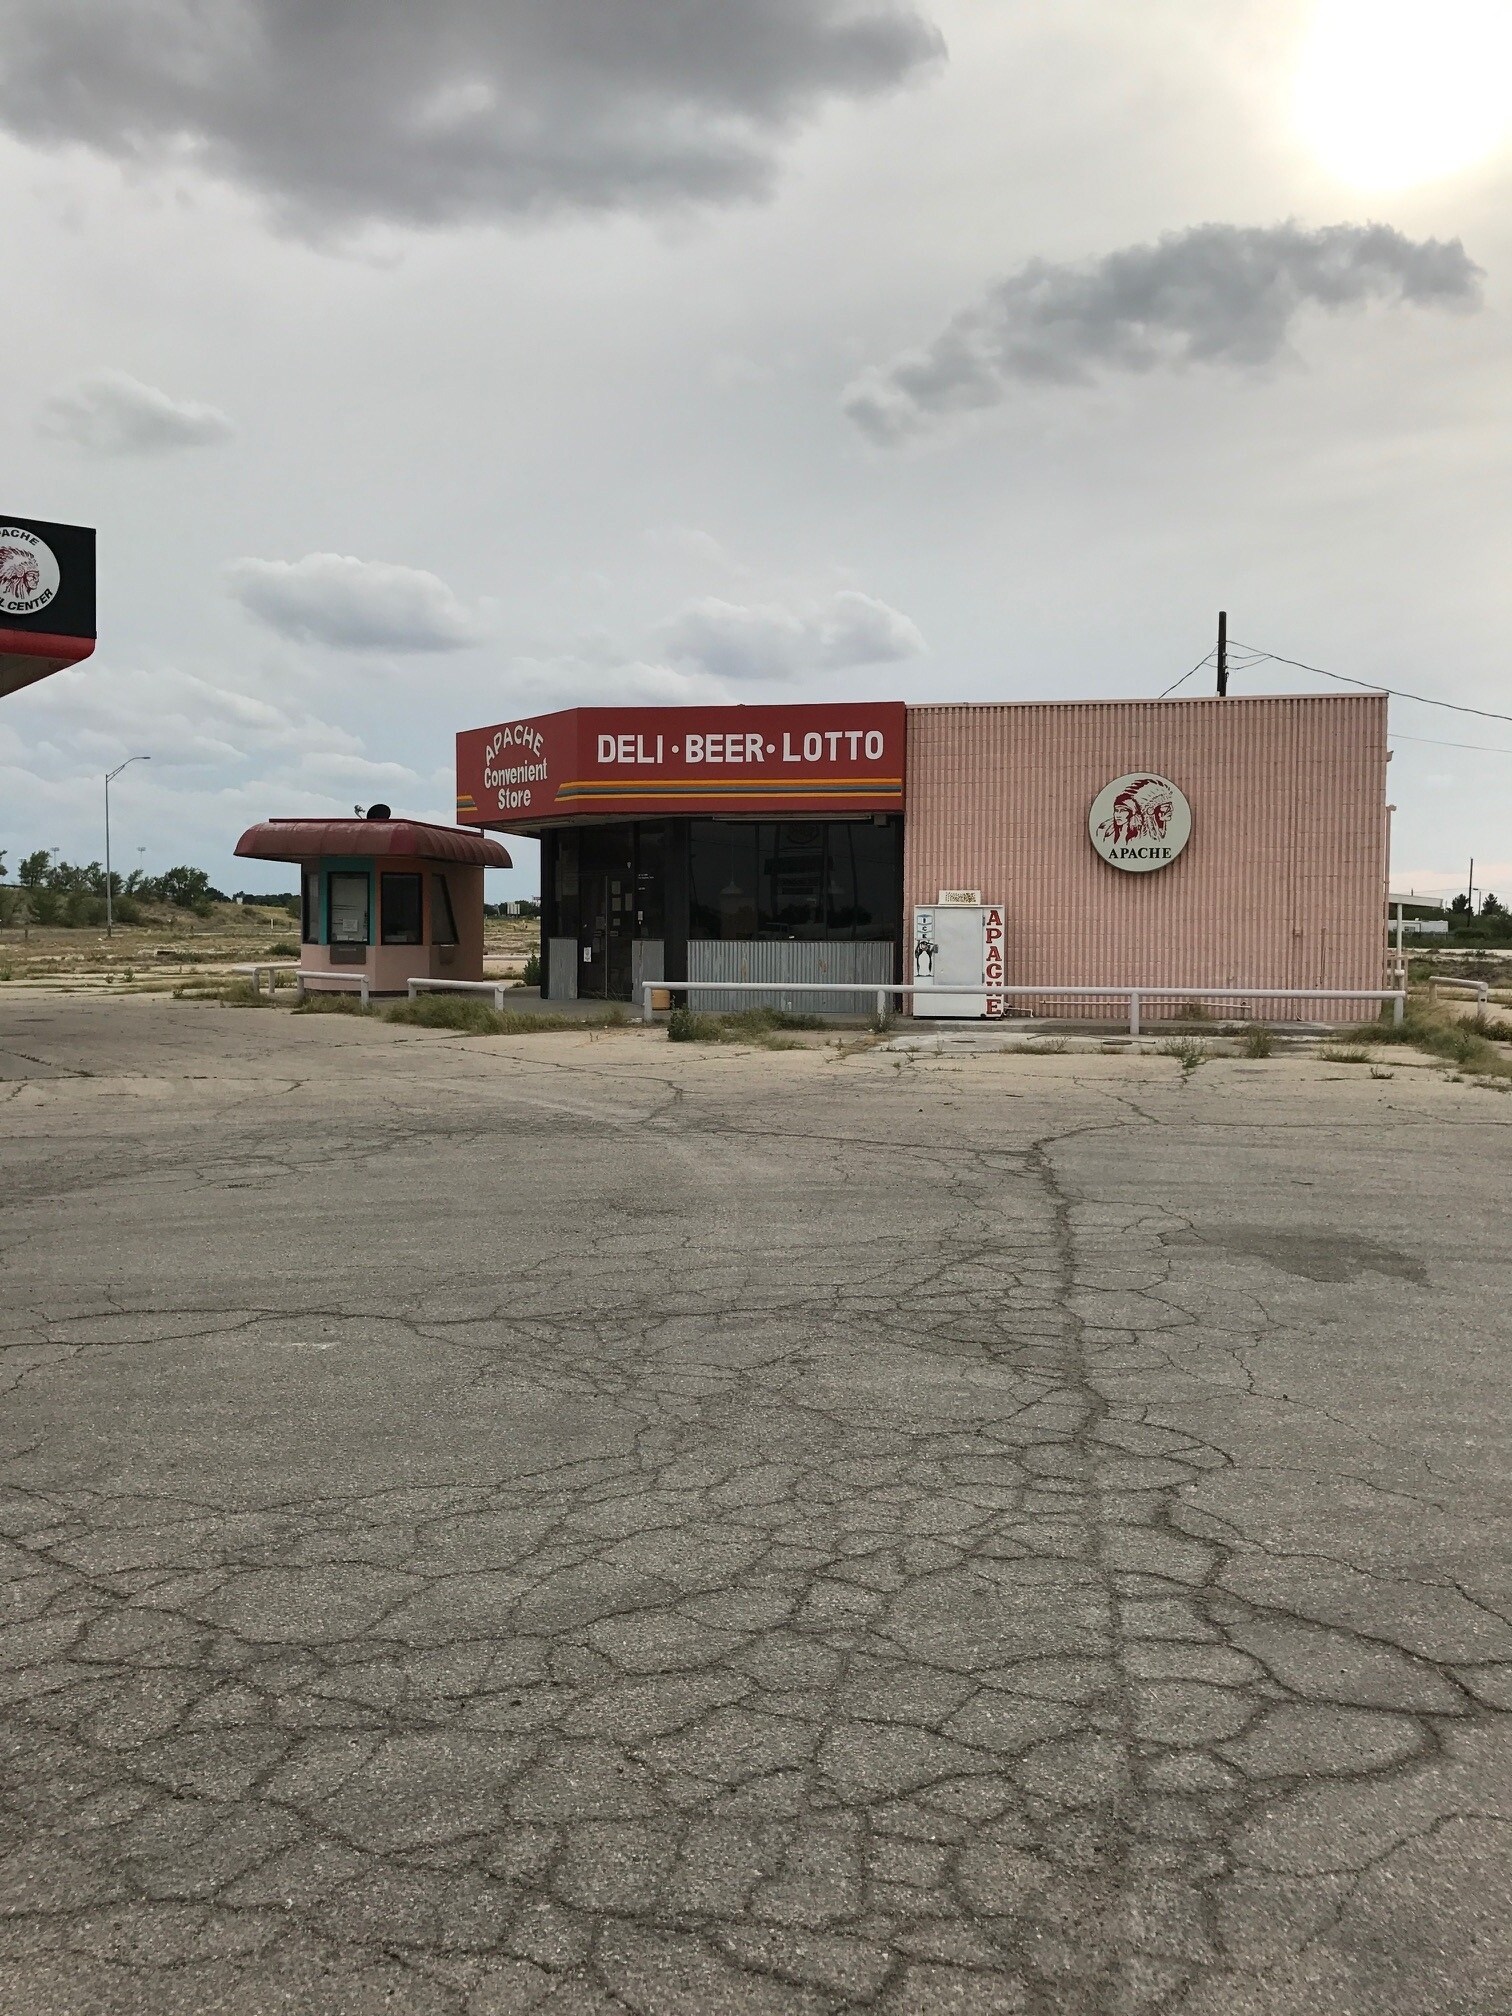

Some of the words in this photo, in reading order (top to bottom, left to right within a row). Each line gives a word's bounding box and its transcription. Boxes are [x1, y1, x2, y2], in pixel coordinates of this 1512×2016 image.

[0, 529, 40, 546] ACHE
[7, 588, 53, 611] CENTER
[485, 724, 544, 767] APACHE
[597, 734, 664, 764] DELI
[685, 733, 765, 763] BEER
[782, 730, 885, 762] LOTTO
[484, 757, 548, 789] Convenient
[497, 787, 532, 810] Store
[1108, 847, 1172, 859] APACHE
